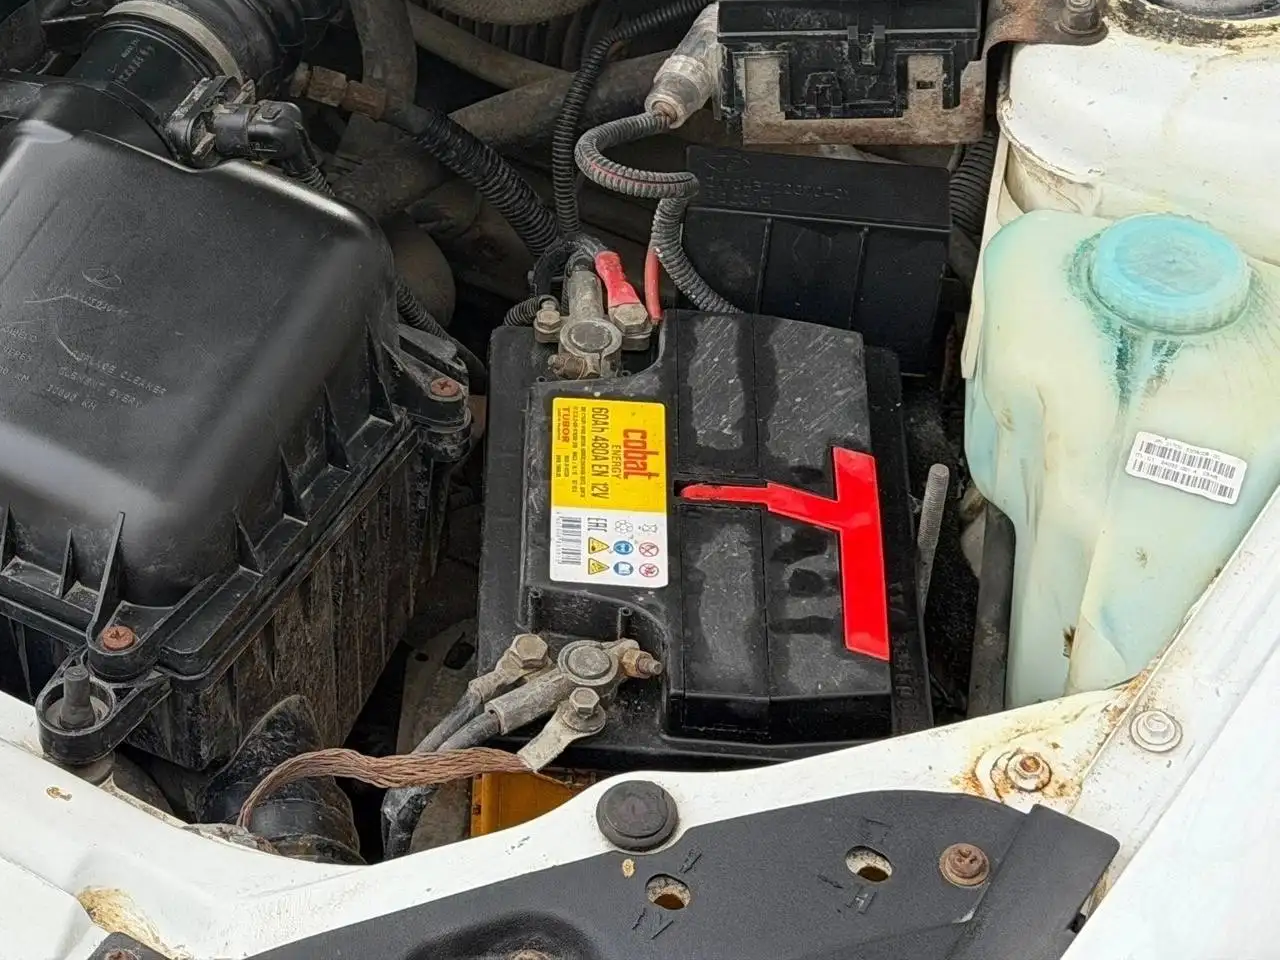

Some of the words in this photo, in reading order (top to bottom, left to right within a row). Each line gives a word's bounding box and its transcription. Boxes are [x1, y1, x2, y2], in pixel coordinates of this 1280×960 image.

[561, 407, 571, 443] TUBOR
[591, 407, 609, 433] 60Ah
[591, 436, 609, 462] 480A
[611, 444, 622, 480] ENERGY
[623, 428, 660, 480] cobat
[591, 464, 609, 477] EN
[591, 482, 610, 500] 12V
